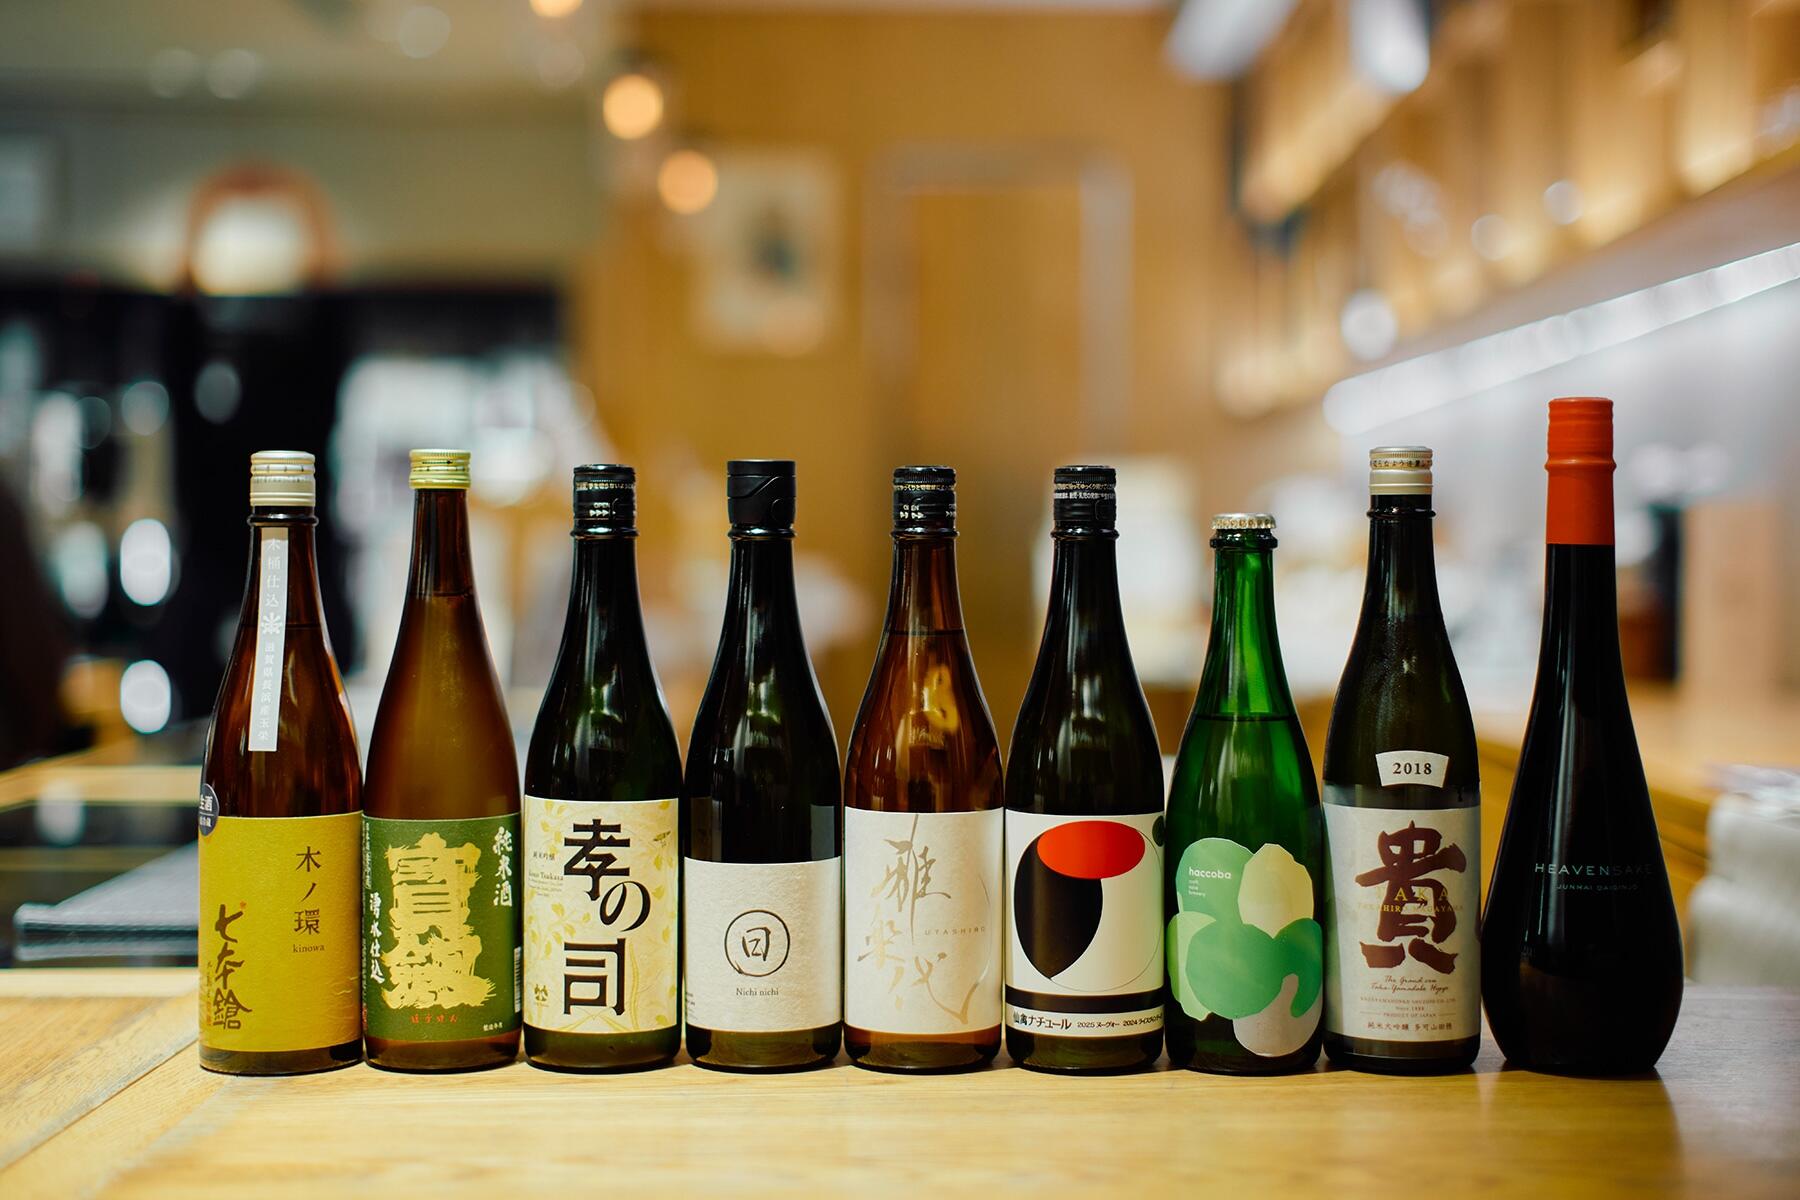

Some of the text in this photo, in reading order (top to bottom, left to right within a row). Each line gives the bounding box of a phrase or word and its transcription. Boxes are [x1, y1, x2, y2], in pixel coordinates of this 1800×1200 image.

[264, 538, 282, 608] 木桶仕込
[1392, 761, 1433, 776] 2018
[491, 826, 513, 908] 純米酒
[1189, 866, 1232, 879] haccoba
[1534, 863, 1653, 876] HEAVENSAKE
[293, 846, 322, 936] 木ノ環
[1557, 883, 1593, 891] JUNMAI
[1355, 819, 1467, 975] 貴
[563, 818, 651, 1017] 孝の司
[292, 942, 326, 954] kinowa
[1399, 976, 1423, 986] Grand
[736, 987, 779, 997] Nichi nichi
[1013, 1011, 1072, 1030] 仙禽ナチュール
[1123, 1019, 1138, 1027] 2024
[1367, 1021, 1409, 1031] 純米大吟醸
